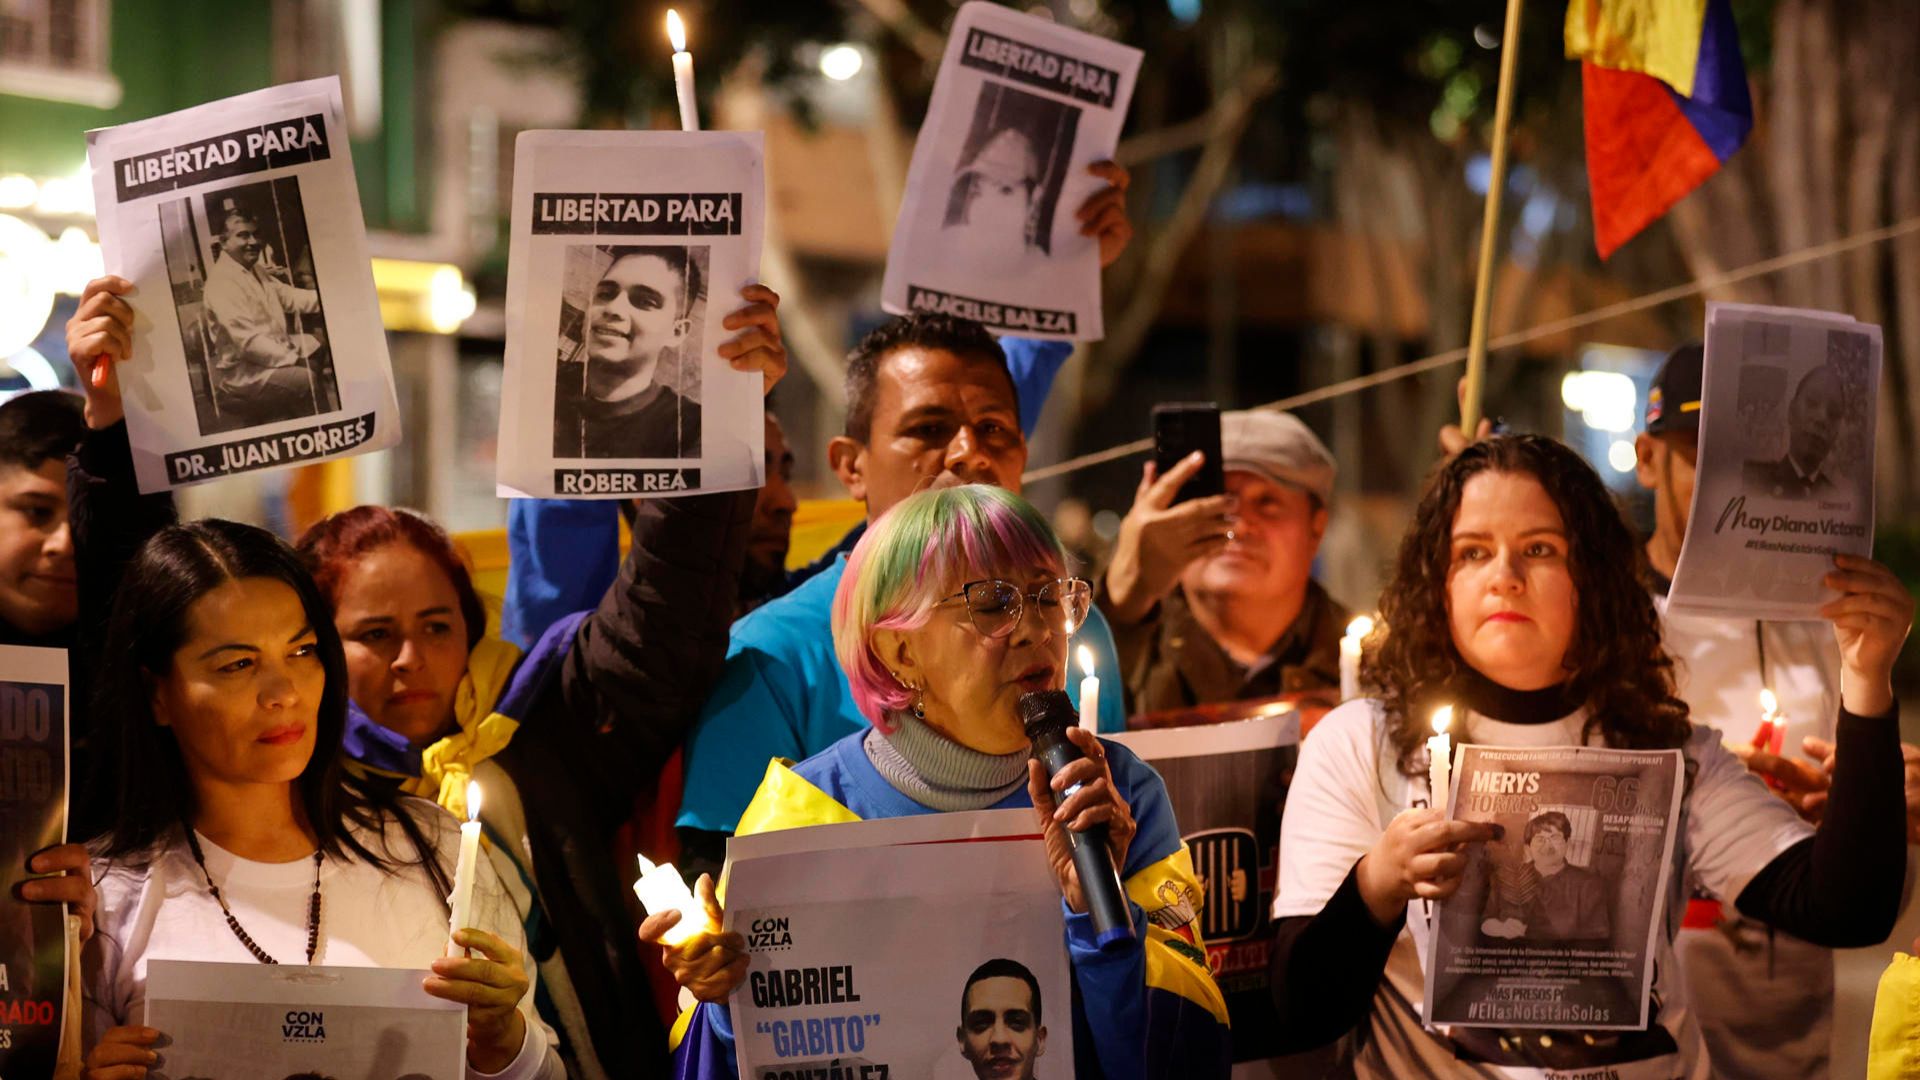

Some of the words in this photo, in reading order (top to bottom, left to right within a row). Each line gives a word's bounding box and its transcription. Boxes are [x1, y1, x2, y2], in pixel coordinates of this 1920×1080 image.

[969, 35, 1057, 77] LIBERTAD
[1060, 65, 1111, 94] PARA
[125, 139, 241, 188] LIBERTAD
[247, 122, 323, 159] PARA
[541, 199, 660, 222] LIBERTAD
[667, 199, 734, 222] PARA
[911, 291, 1001, 324] ARACELIS
[1004, 306, 1072, 332] BALZA
[174, 451, 215, 480] DR.
[220, 440, 279, 472] JUAN
[282, 419, 368, 455] TORRES
[562, 473, 637, 493] ROBER
[643, 472, 688, 491] REA
[1715, 495, 1769, 535] May
[1772, 515, 1818, 534] Diana
[1471, 770, 1541, 794] MERYS
[1592, 775, 1641, 813] 66
[1471, 793, 1540, 813] TORRES
[752, 917, 790, 934] CON
[748, 932, 793, 949] VZLA
[750, 964, 861, 1009] GABRIEL
[285, 1010, 324, 1026] CON
[1468, 1002, 1610, 1022] #EllasNoEstánSolas
[281, 1025, 326, 1039] VZLA
[756, 1013, 881, 1059] “GABITO”
